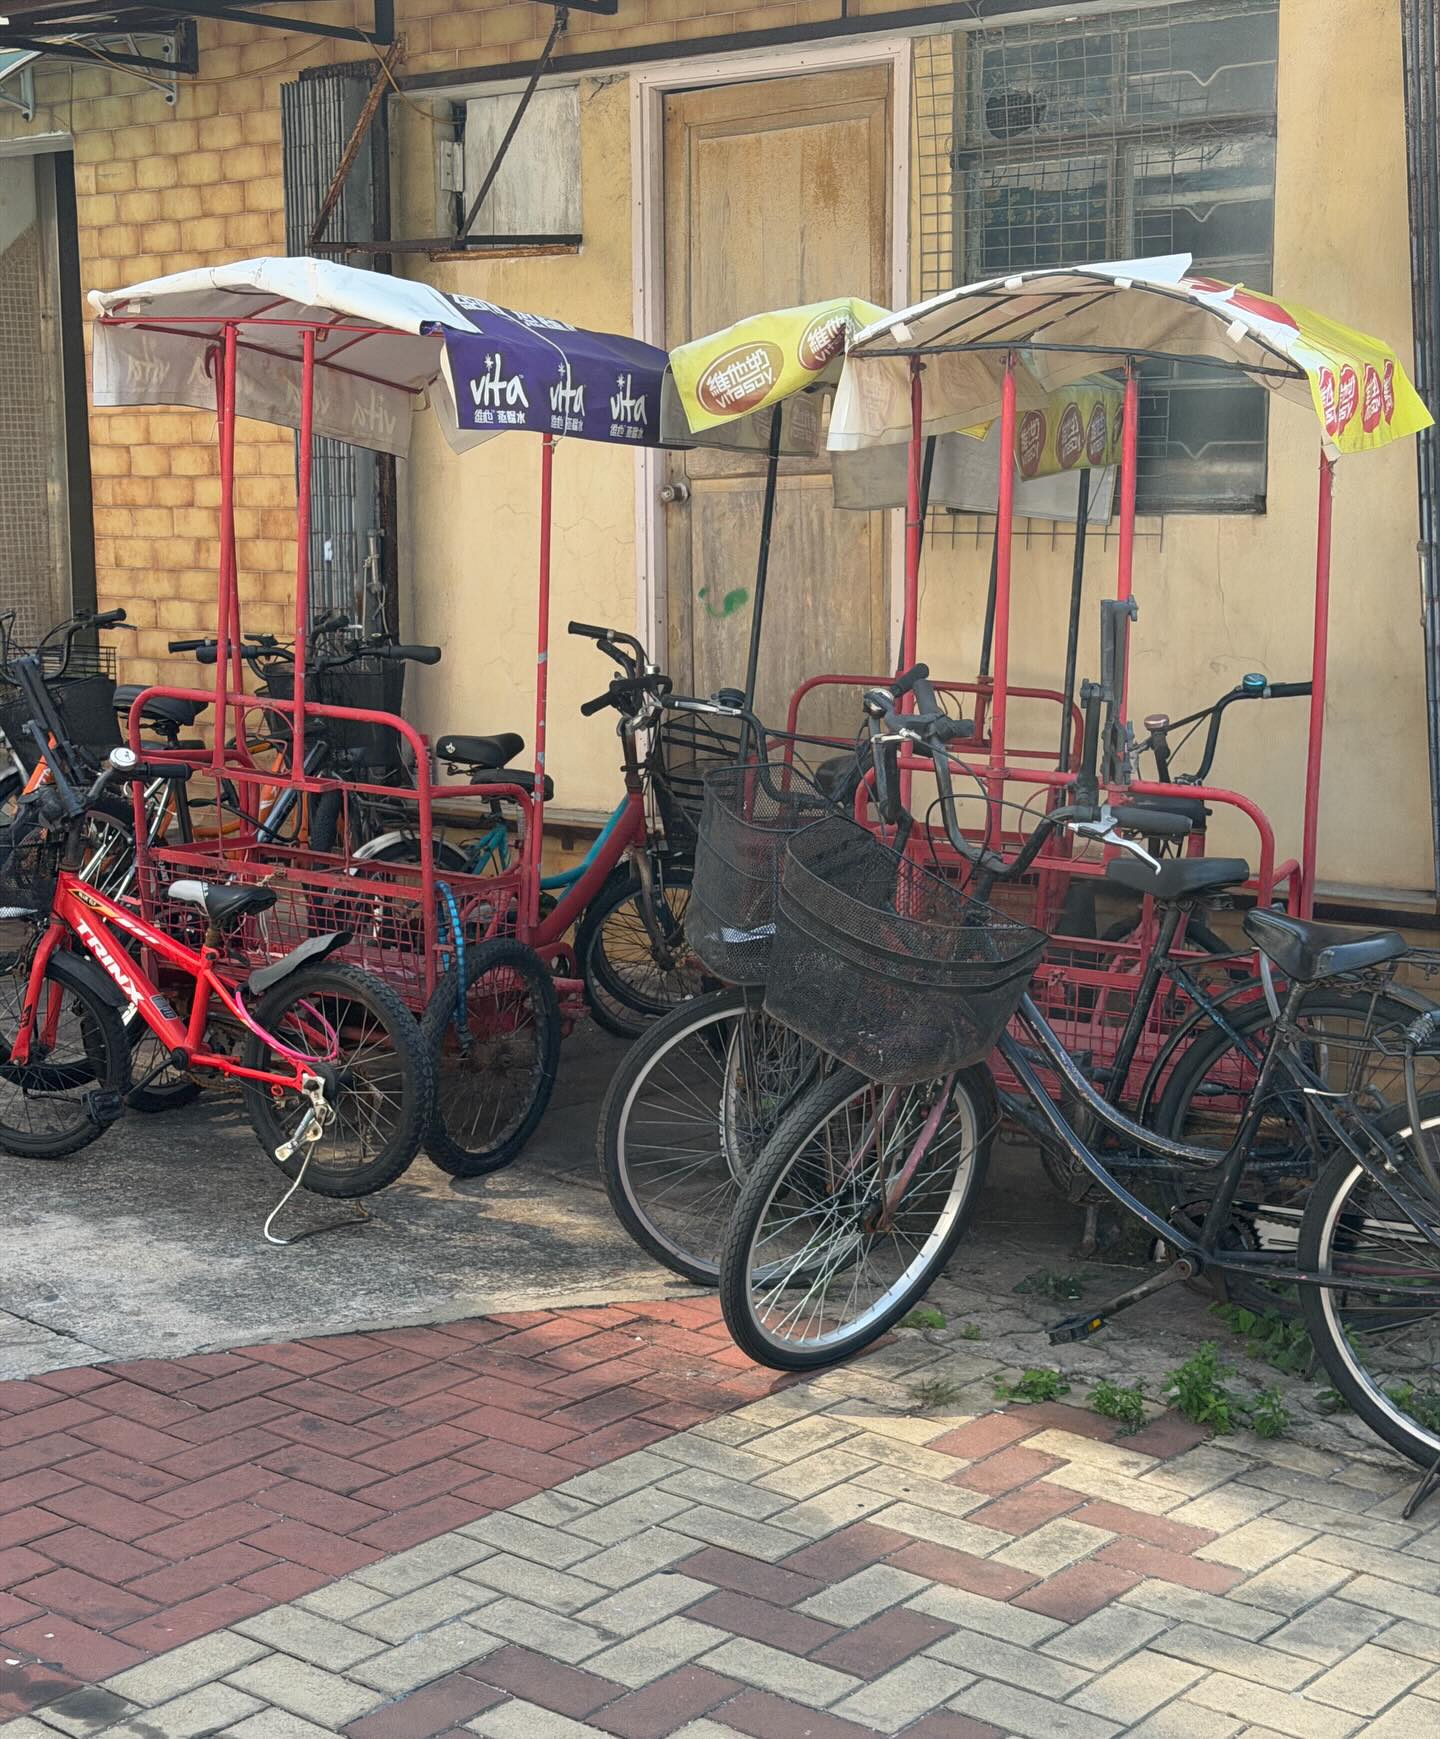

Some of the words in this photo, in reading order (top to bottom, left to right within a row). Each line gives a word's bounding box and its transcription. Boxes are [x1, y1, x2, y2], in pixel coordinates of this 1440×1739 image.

[470, 353, 529, 408] vita
[550, 362, 585, 417] vita
[610, 373, 648, 425] vita
[706, 348, 771, 398] 維他奶
[77, 918, 144, 1006] TRINX
